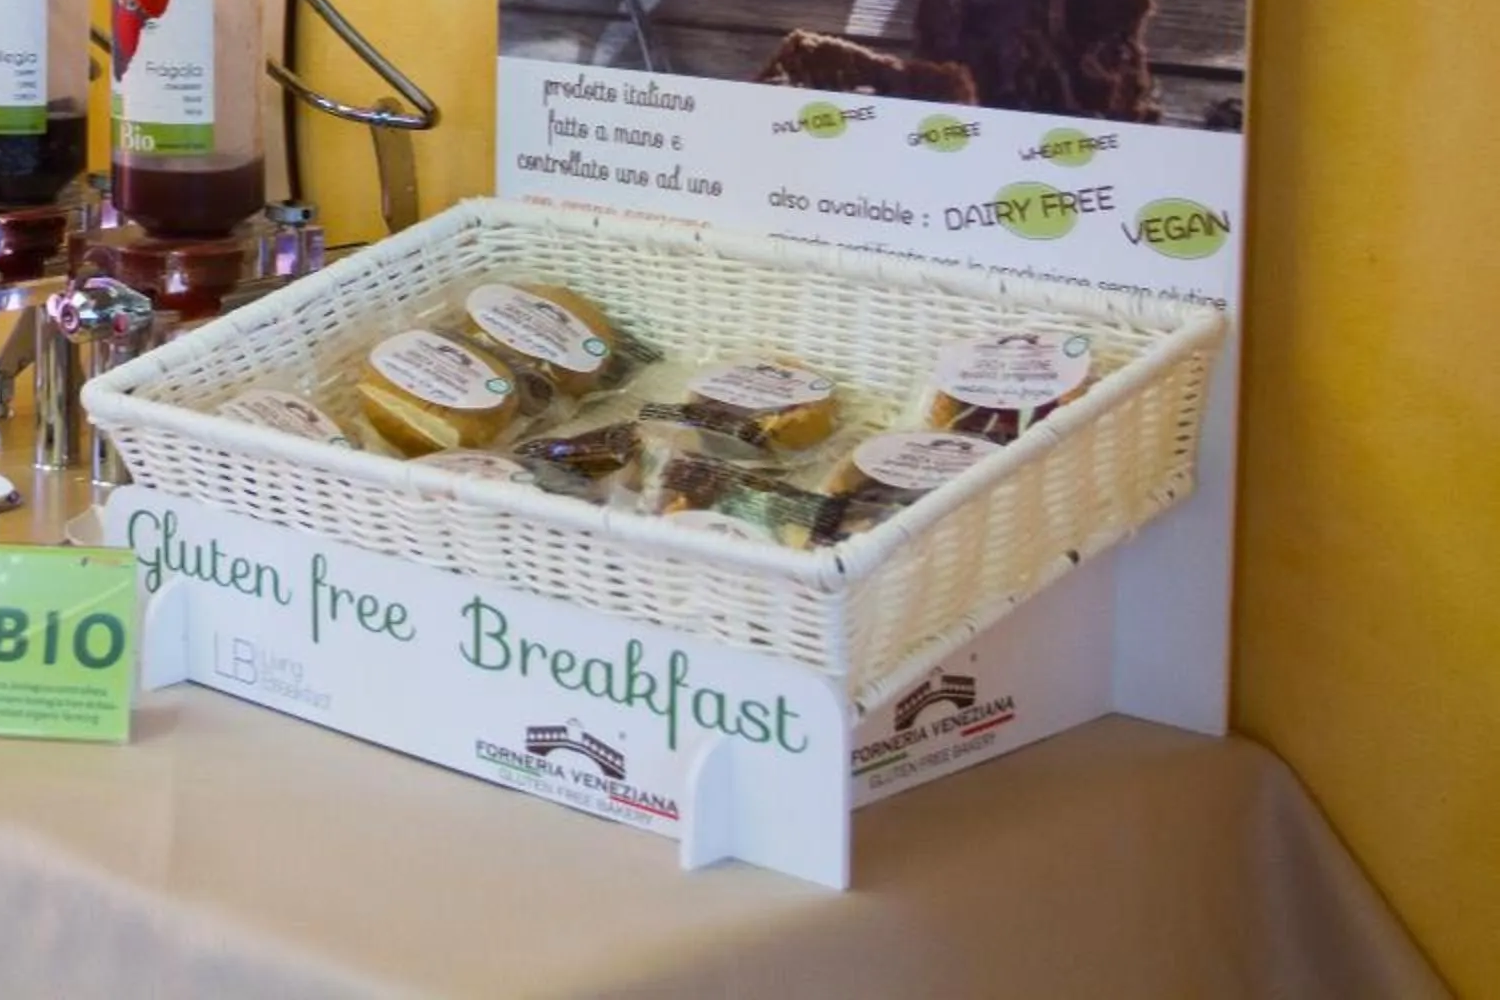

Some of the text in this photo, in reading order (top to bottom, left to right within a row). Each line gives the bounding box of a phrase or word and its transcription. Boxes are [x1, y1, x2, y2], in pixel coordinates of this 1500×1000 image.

[543, 73, 696, 113] prodotto italiano
[548, 108, 589, 146] fatto
[595, 124, 609, 142] a
[614, 125, 665, 149] mano
[840, 105, 877, 122] FREE
[119, 121, 155, 151] Bio
[907, 121, 982, 147] GMO FREE
[1018, 133, 1120, 162] WHEAT FREE
[614, 166, 650, 188] uno
[655, 164, 682, 191] ad
[686, 176, 724, 197] uno
[768, 187, 811, 212] also
[817, 195, 914, 226] available
[944, 199, 1032, 232] DAIRY
[1041, 185, 1116, 220] FREE
[1120, 209, 1231, 246] VEGAN
[127, 508, 809, 755] Gluten free Breakfast
[850, 695, 1015, 765] FORNERIA VENEZIANA
[475, 739, 680, 814] FORNERIA VENEZIANA
